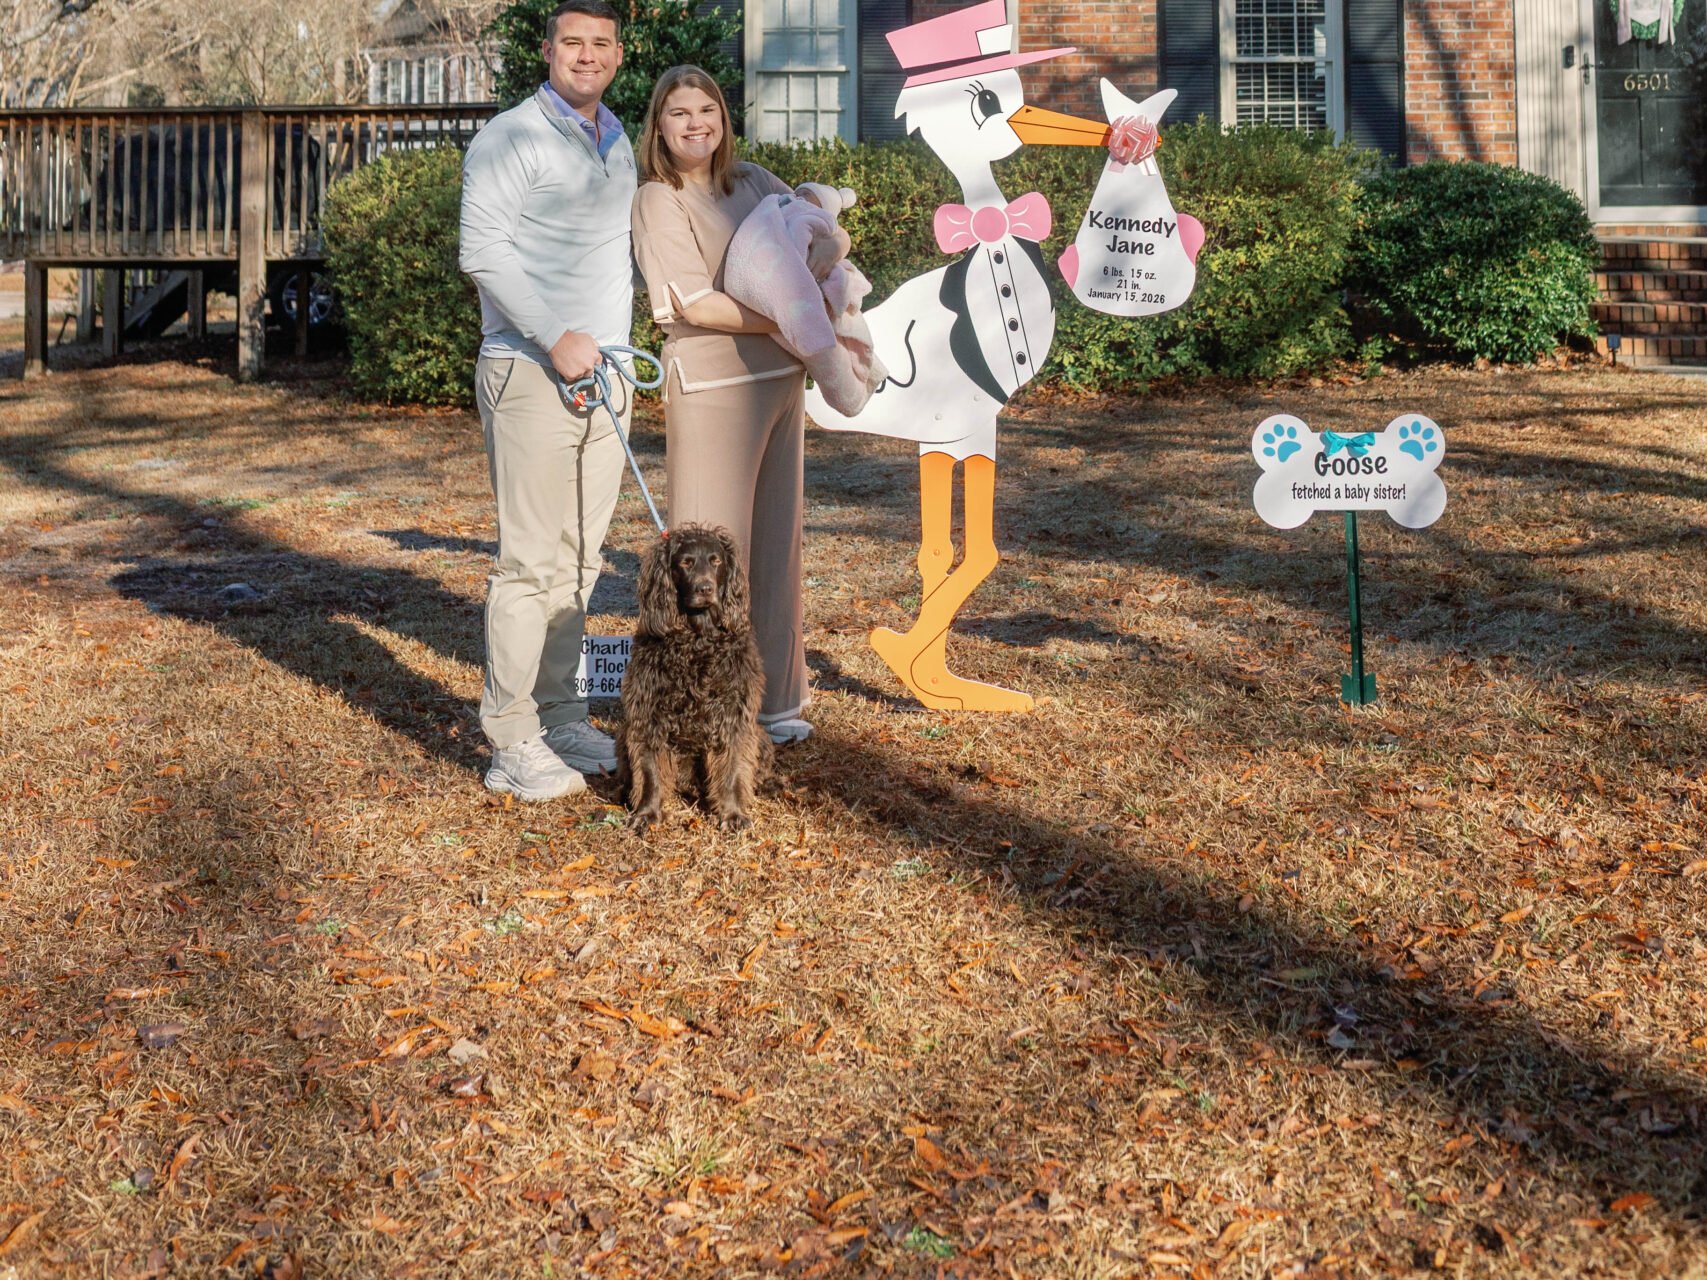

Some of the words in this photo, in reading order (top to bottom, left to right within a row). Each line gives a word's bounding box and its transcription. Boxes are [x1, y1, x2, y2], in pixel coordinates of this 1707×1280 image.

[1624, 73, 1671, 91] 6501
[1089, 210, 1176, 238] Kennedy
[1106, 235, 1155, 256] Jane
[1103, 266, 1109, 276] 6
[1111, 266, 1125, 277] lbs.
[1131, 268, 1142, 279] 15
[1144, 271, 1157, 281] oz.
[1116, 279, 1127, 289] 21
[1131, 280, 1141, 290] in.
[1087, 288, 1121, 301] January
[1141, 293, 1166, 304] 2026
[1314, 451, 1388, 477] Goose
[1291, 482, 1331, 500] fetched
[1334, 488, 1341, 499] a
[1344, 483, 1370, 502] baby
[1373, 483, 1406, 500] sister!
[581, 639, 632, 655] Charli
